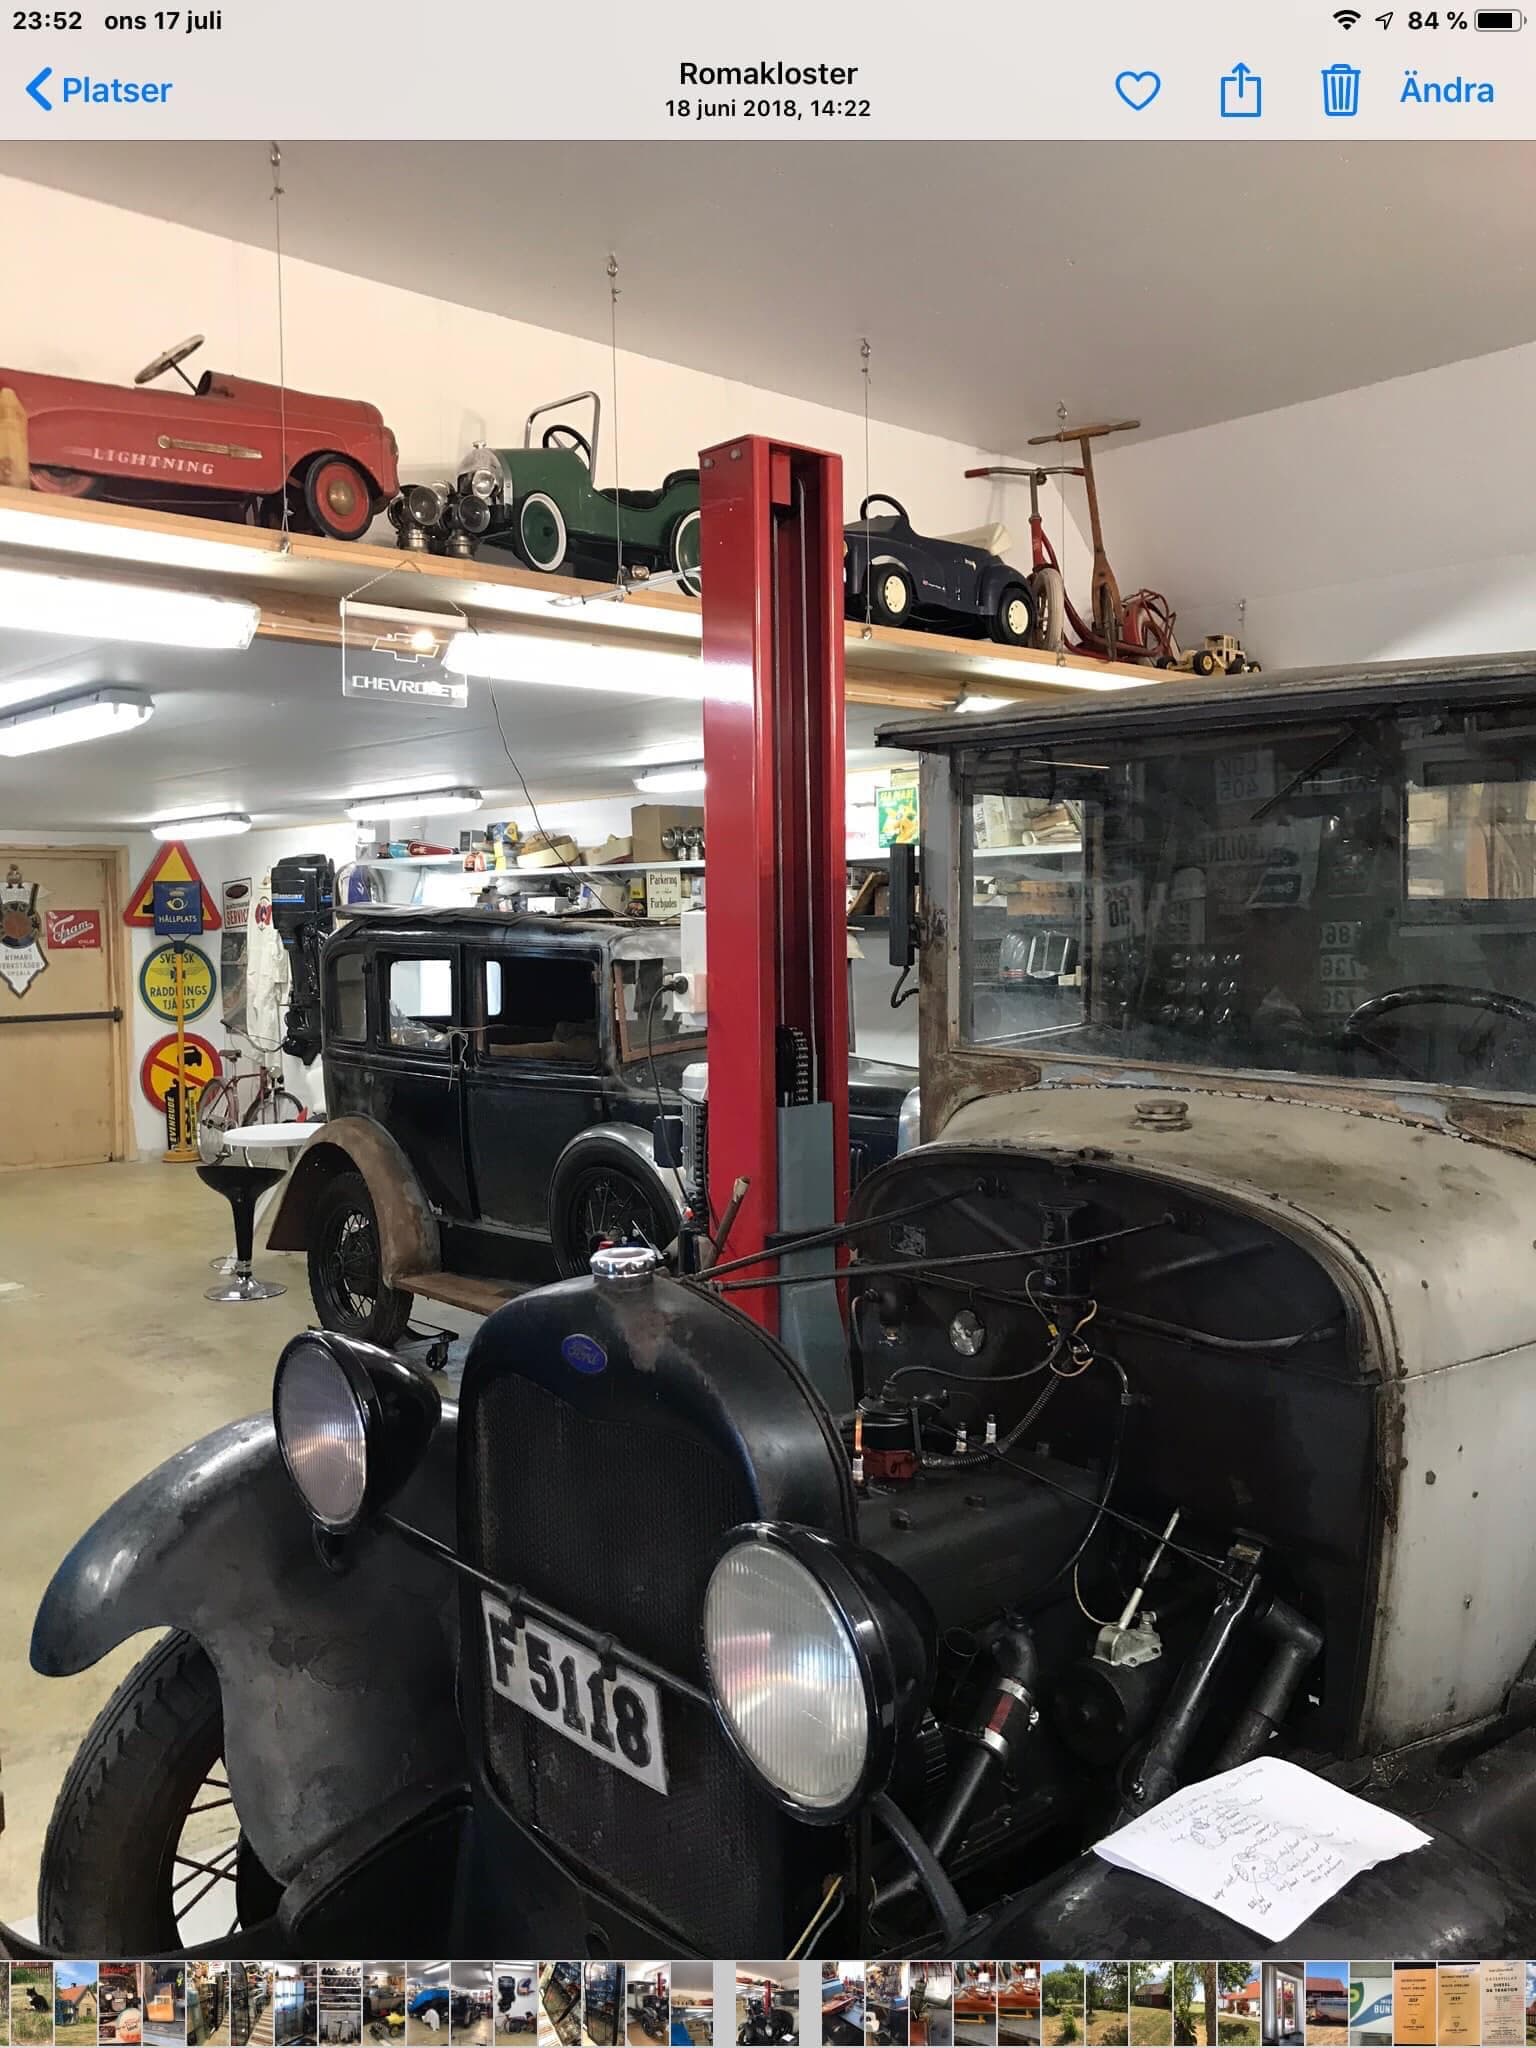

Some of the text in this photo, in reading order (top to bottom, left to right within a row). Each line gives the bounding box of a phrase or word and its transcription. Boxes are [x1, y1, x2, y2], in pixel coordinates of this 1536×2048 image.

[93, 447, 215, 475] LIGHTNING
[226, 908, 248, 926] SERVIC
[160, 953, 195, 964] SVESK
[150, 985, 208, 997] RÄDDINGS
[163, 998, 196, 1010] TJÄST
[488, 1612, 653, 1769] F5118
